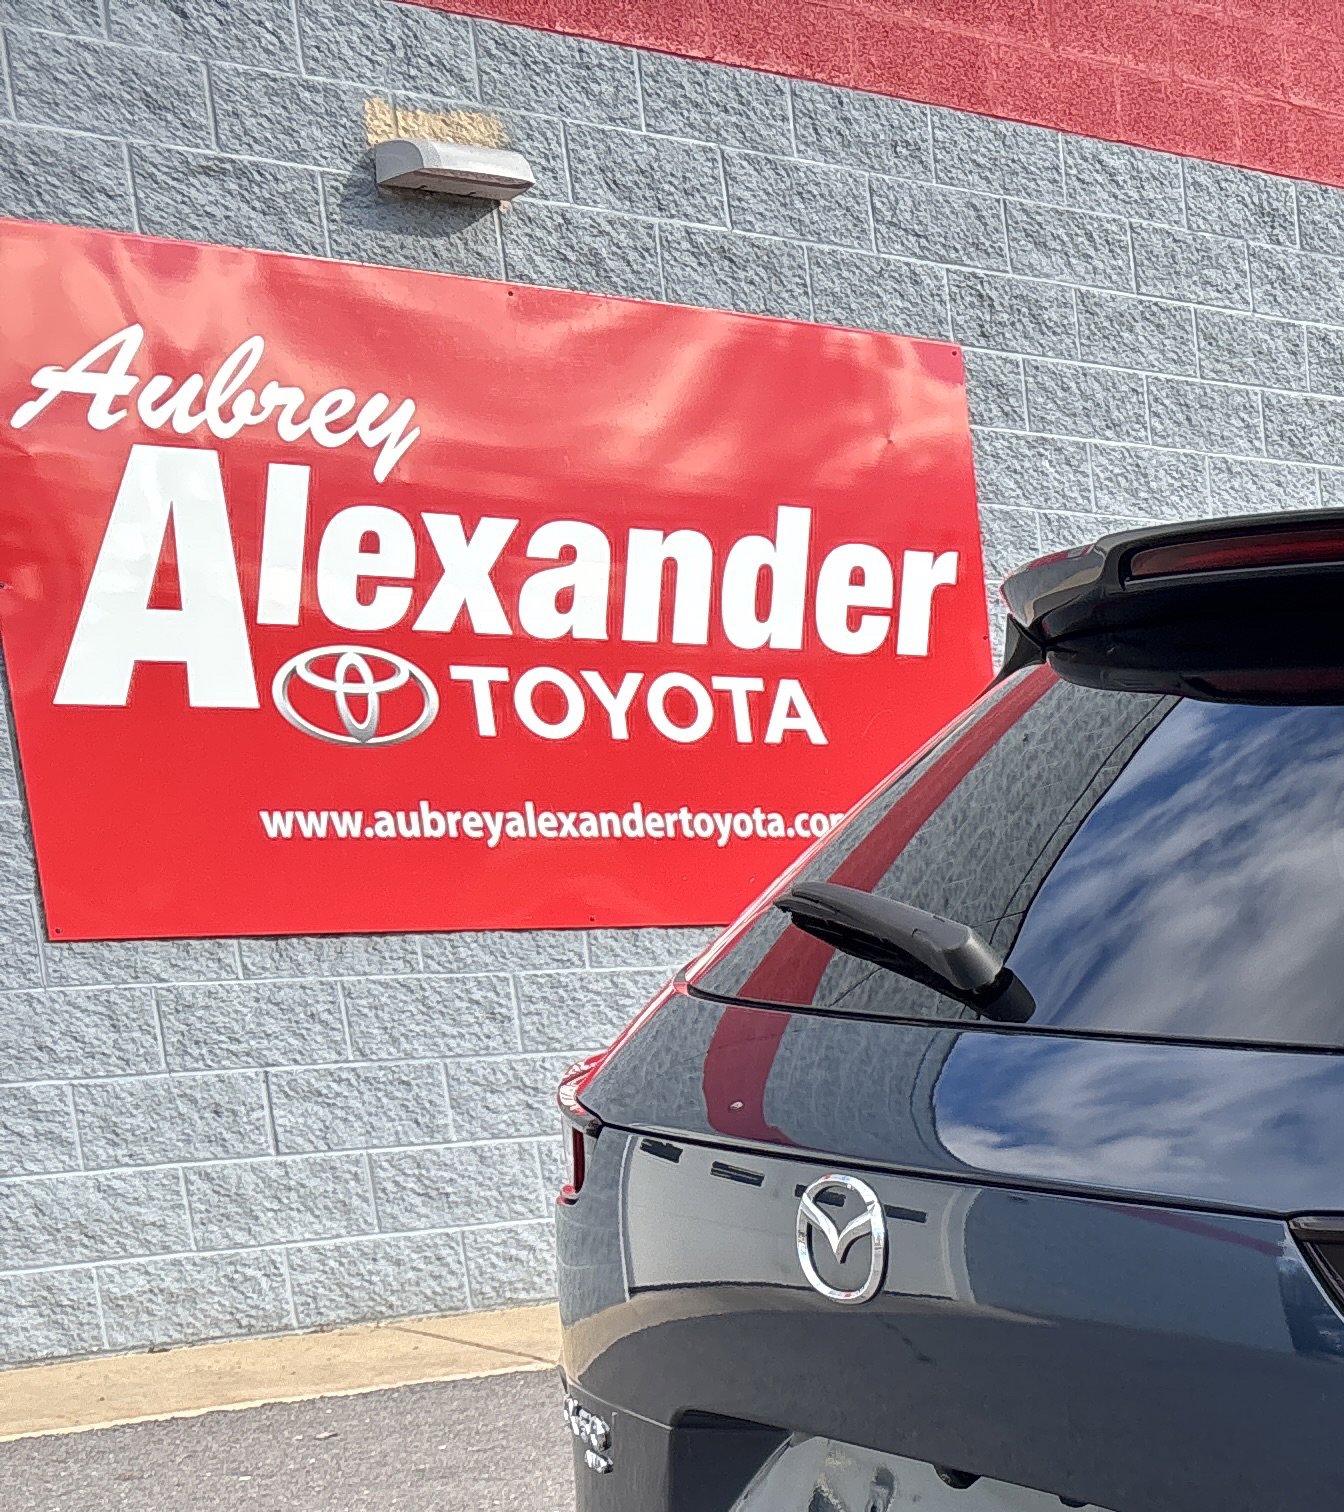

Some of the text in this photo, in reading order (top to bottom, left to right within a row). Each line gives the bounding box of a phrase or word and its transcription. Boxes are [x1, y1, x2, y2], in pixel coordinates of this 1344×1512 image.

[11, 323, 421, 483] Aubrey
[53, 444, 959, 709] Alexander
[450, 666, 829, 746] TOYOTA
[260, 801, 846, 850] www.aubreyalexandertoyota.co
